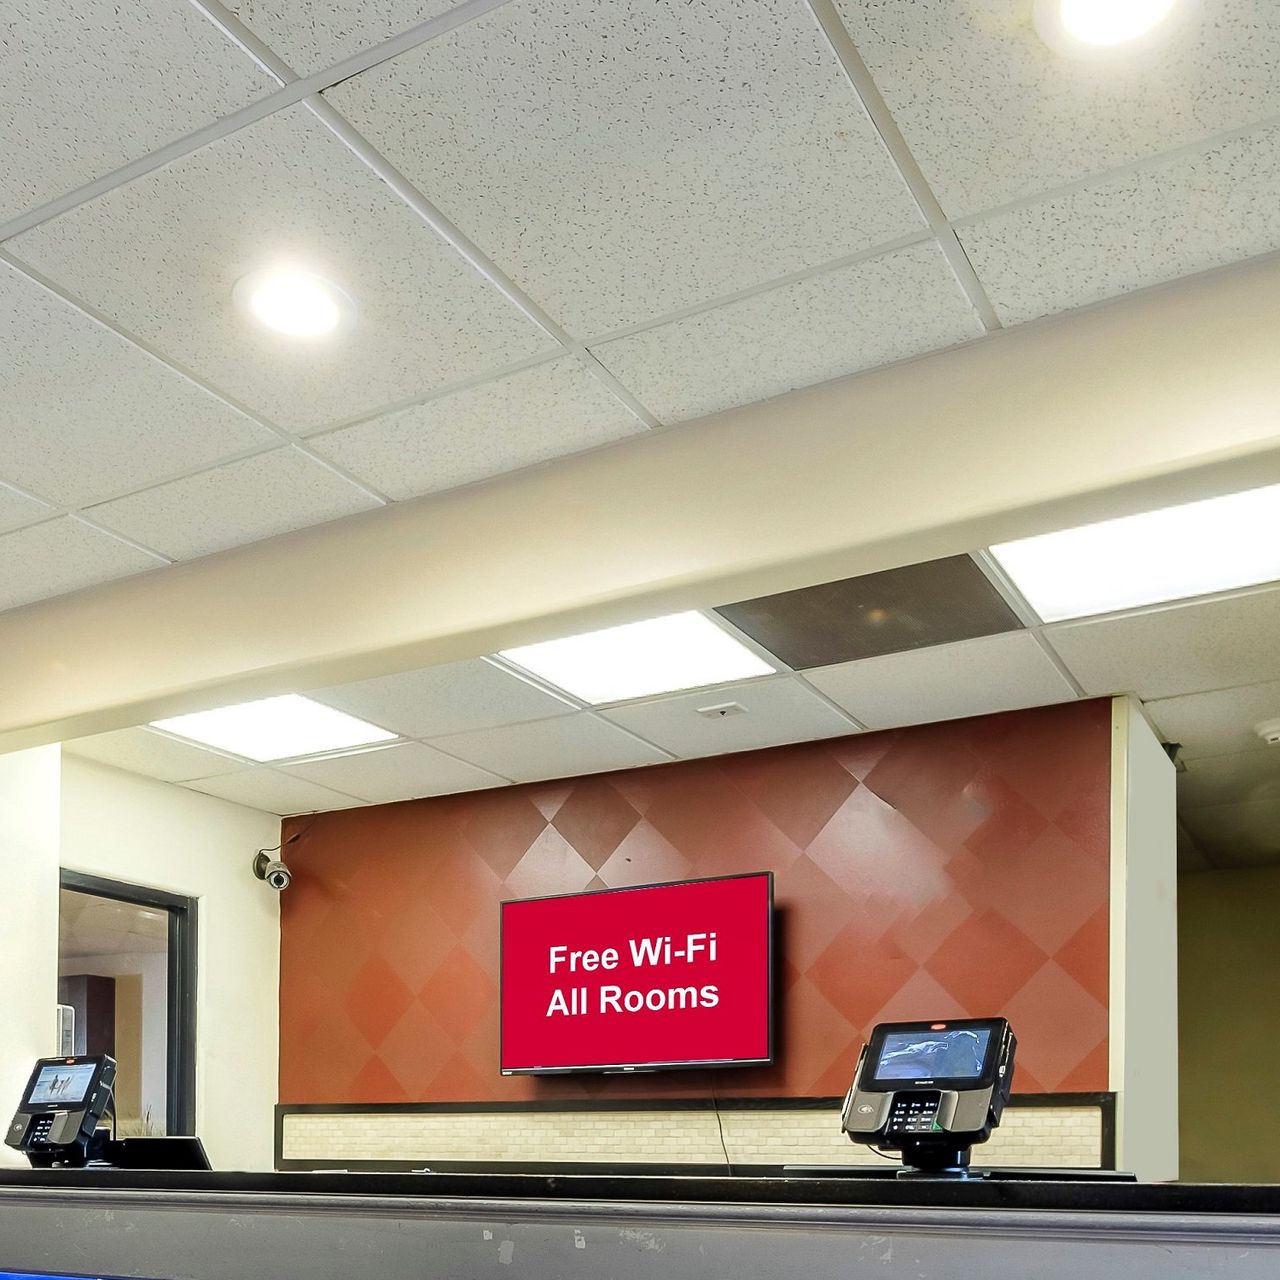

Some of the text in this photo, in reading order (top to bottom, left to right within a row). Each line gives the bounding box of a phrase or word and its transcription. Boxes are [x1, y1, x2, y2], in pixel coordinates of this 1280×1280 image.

[549, 932, 717, 974] Free Wi-Fi
[546, 984, 720, 1017] All Rooms
